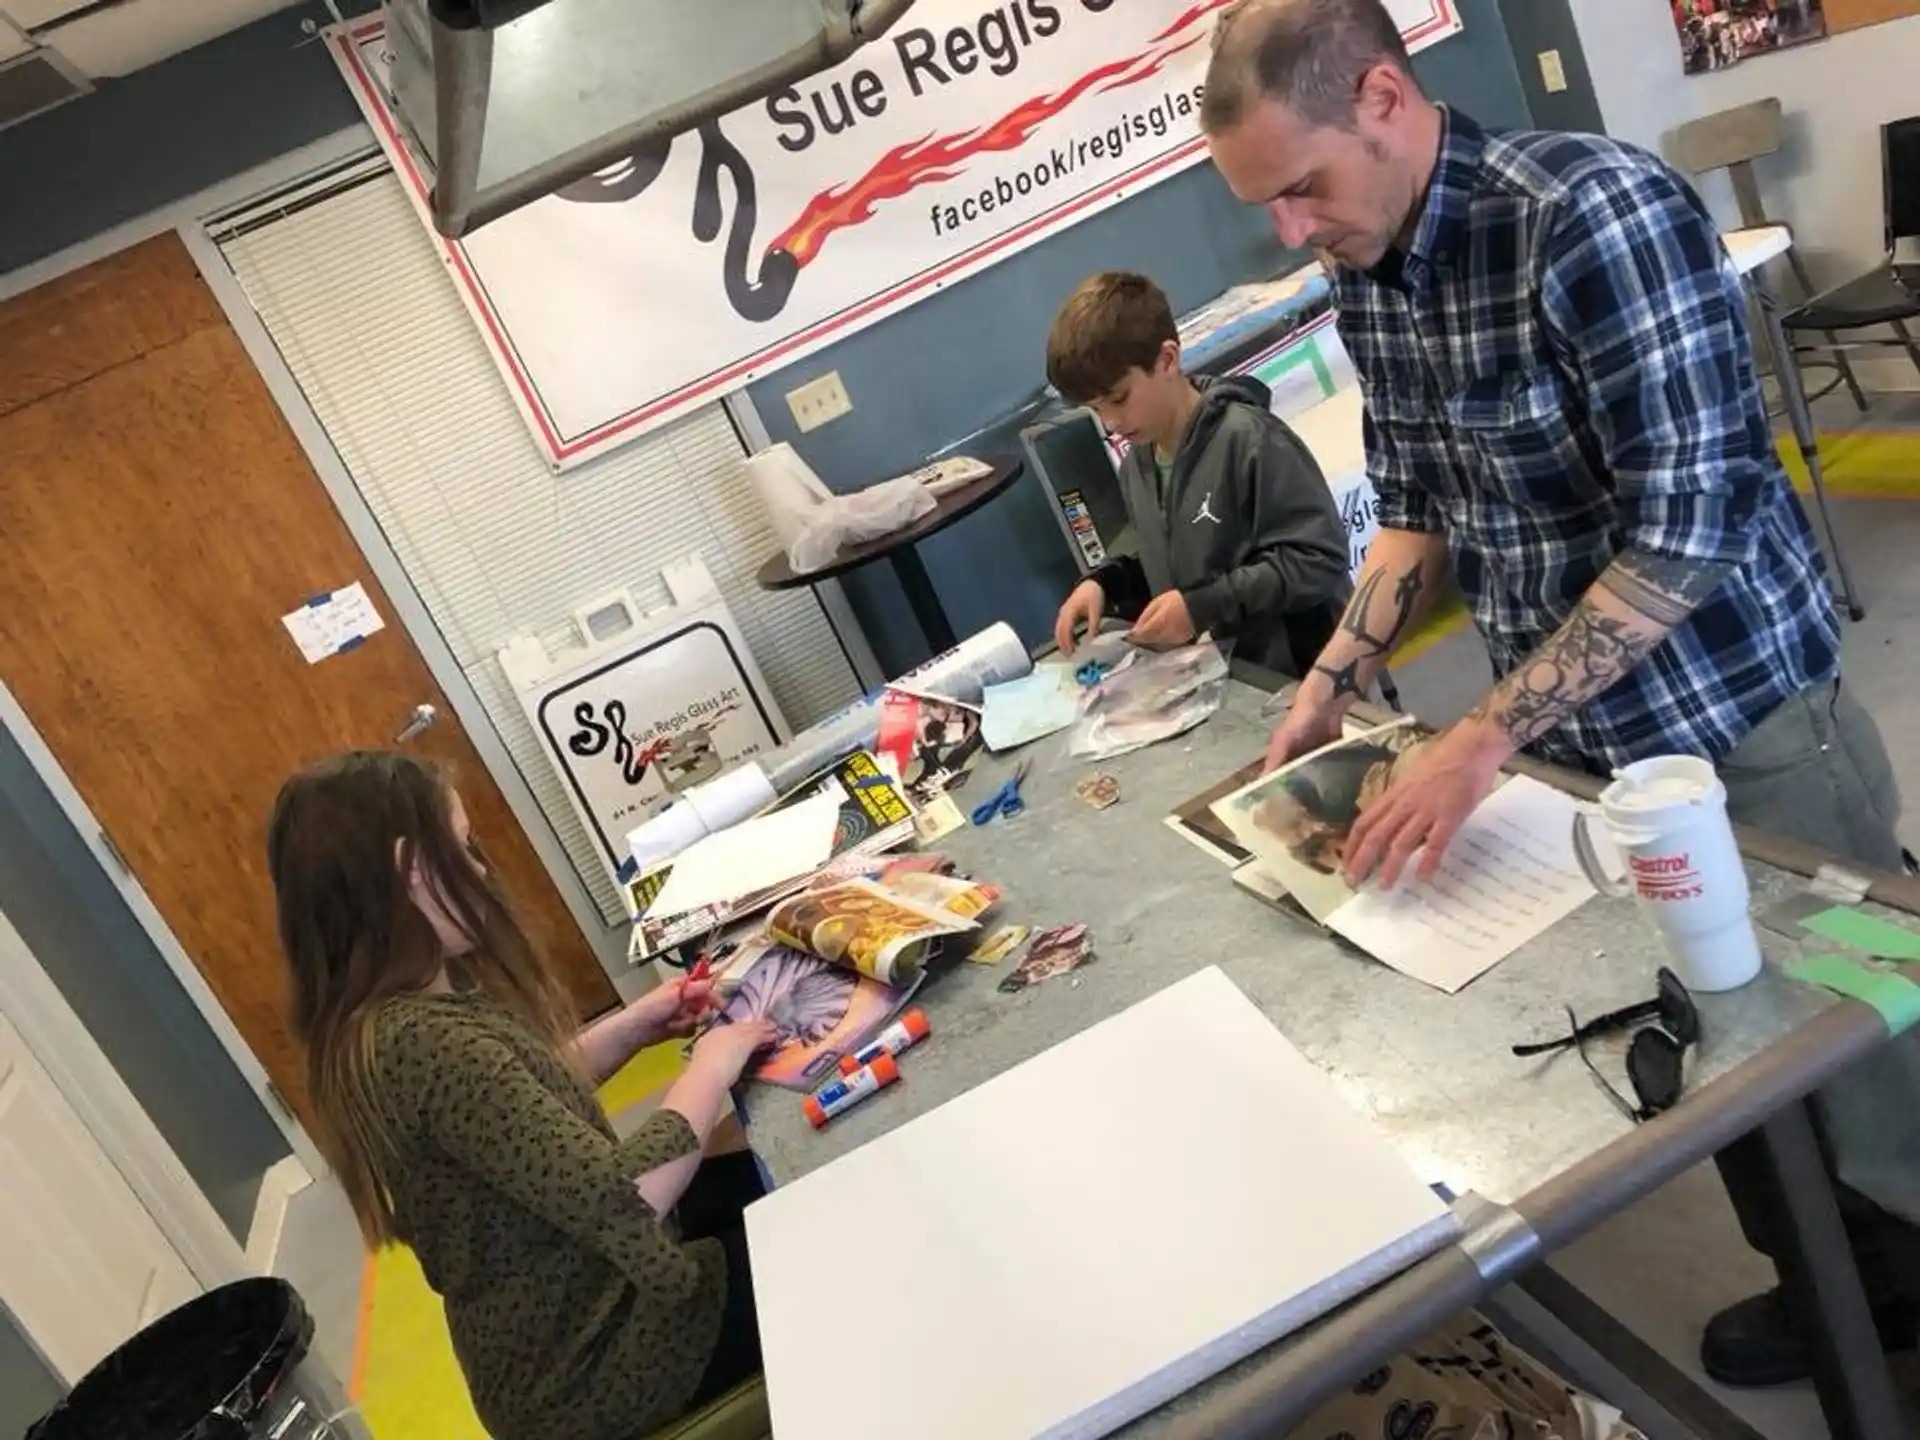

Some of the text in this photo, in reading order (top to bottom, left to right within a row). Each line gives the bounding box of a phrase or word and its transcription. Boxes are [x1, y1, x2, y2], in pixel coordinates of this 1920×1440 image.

[766, 0, 1062, 153] Sue Regis
[630, 728, 655, 746] Sue
[654, 712, 688, 735] Regis
[720, 687, 741, 704] Art
